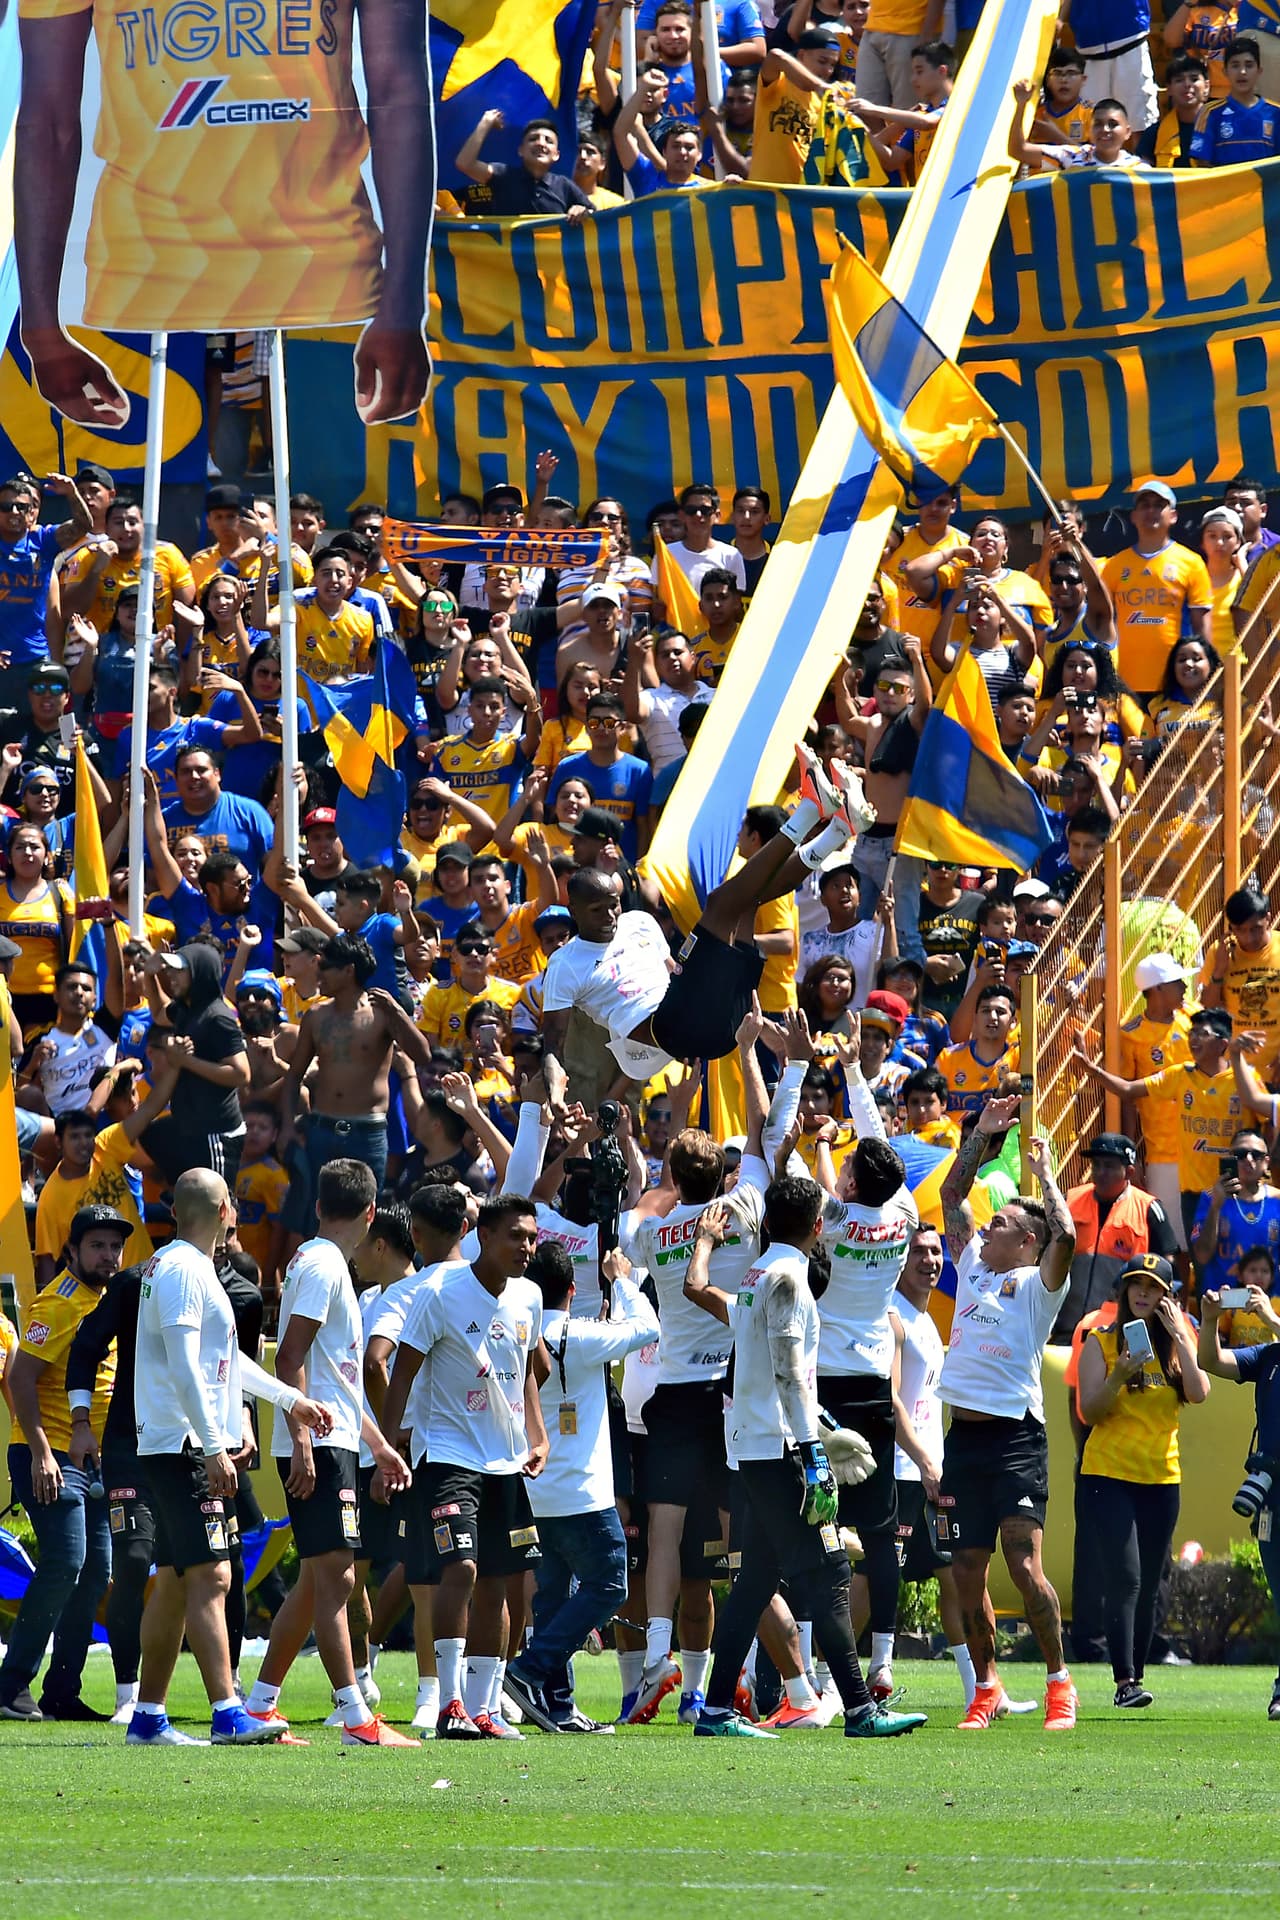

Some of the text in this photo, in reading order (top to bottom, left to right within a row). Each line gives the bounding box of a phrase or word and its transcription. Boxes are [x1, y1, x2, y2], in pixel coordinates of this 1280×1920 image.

[116, 0, 340, 69] TIGRES
[206, 101, 309, 124] CEMEX
[479, 548, 587, 565] TIGRES
[451, 771, 499, 786] TIGRES
[0, 923, 57, 936] TIGRES
[1143, 1254, 1160, 1269] U
[129, 1516, 136, 1530] 1
[952, 1522, 960, 1539] 9
[456, 1532, 473, 1549] 35
